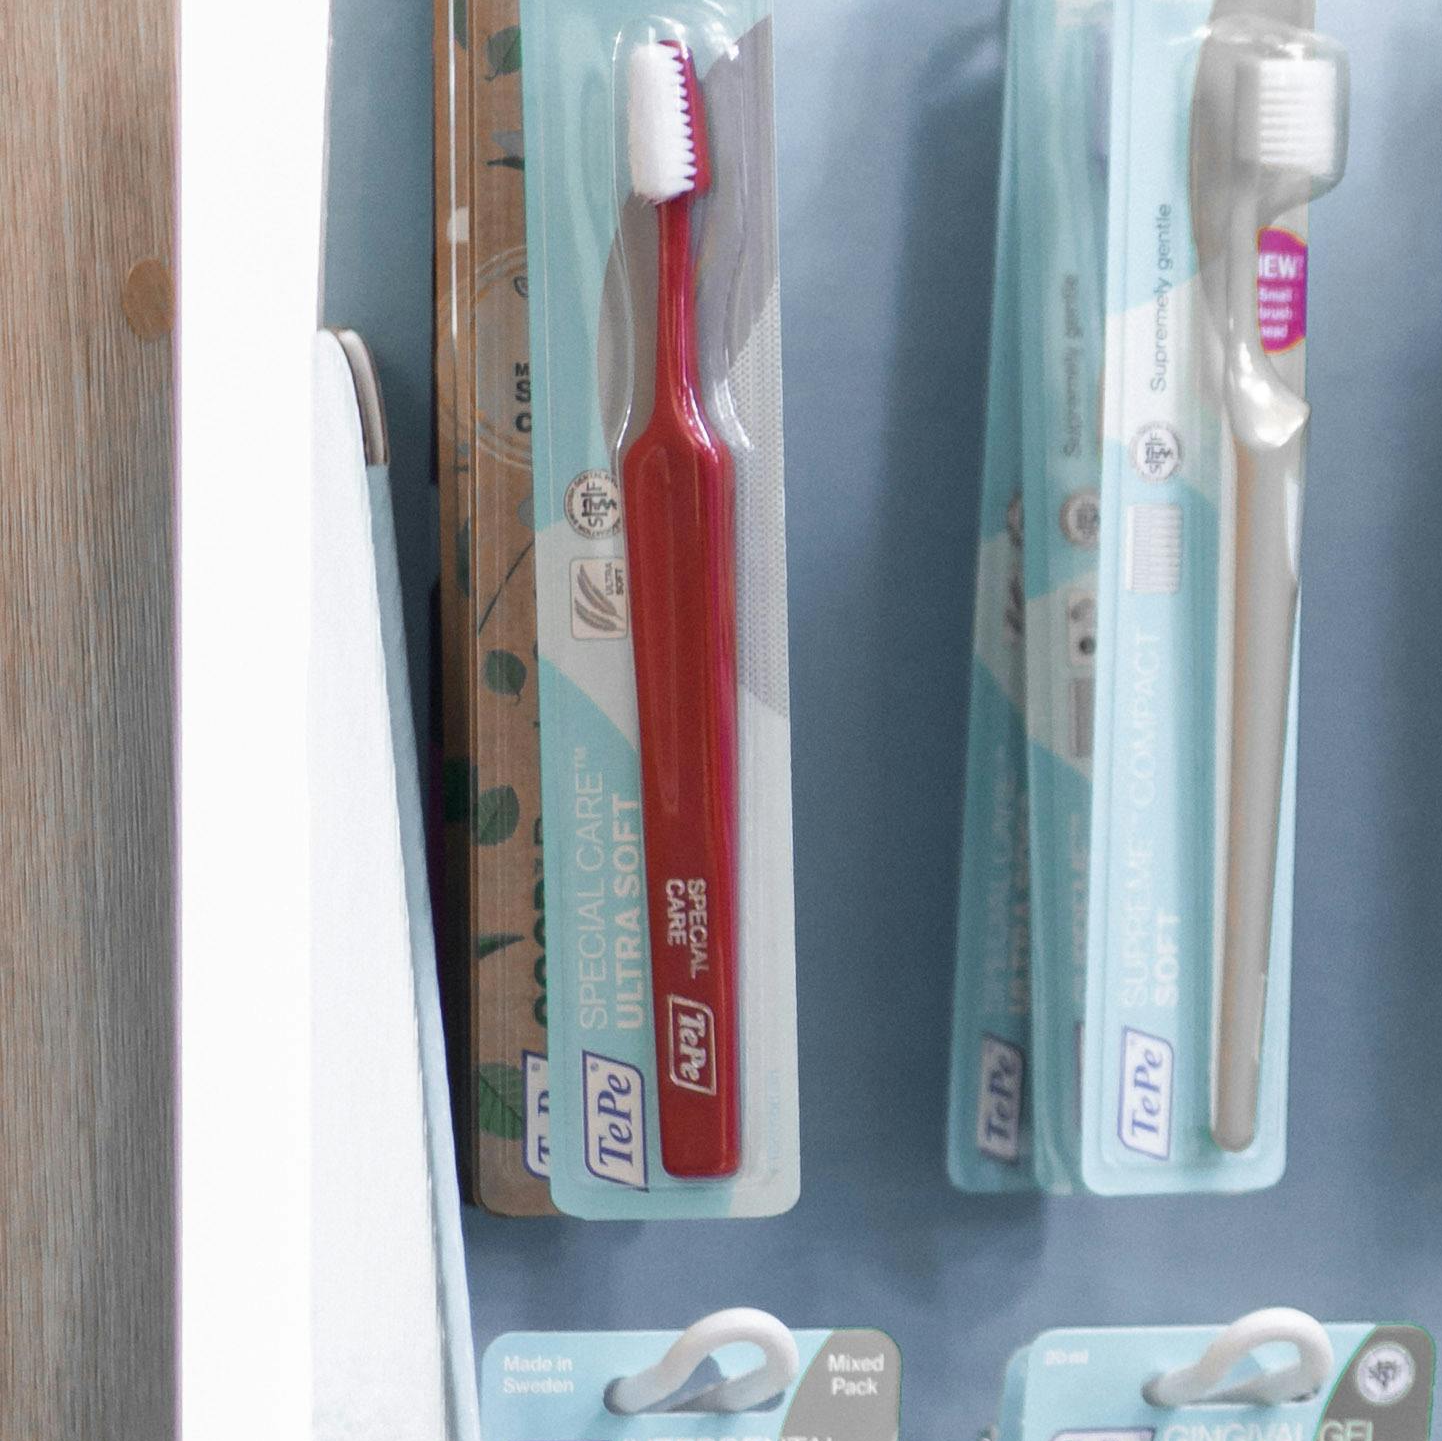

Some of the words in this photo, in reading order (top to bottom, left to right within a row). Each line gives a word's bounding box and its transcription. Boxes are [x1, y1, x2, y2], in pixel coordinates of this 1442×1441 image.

[1152, 203, 1173, 272] gentle
[1150, 279, 1173, 392] Supremely
[612, 793, 640, 897] SOFT
[578, 879, 608, 1031] SPECIAL
[664, 878, 688, 946] CARE
[687, 877, 710, 979] SPECIAL
[614, 903, 646, 1031] ULTRA
[1154, 910, 1179, 1008] SOFT
[680, 1013, 705, 1083] TePe
[1131, 1048, 1164, 1138] TePe
[599, 1073, 633, 1169] TePe
[503, 1355, 553, 1372] Made
[556, 1355, 573, 1372] in
[503, 1376, 574, 1395] Sweden
[828, 1354, 885, 1373] Mixed
[831, 1378, 879, 1396] Pack
